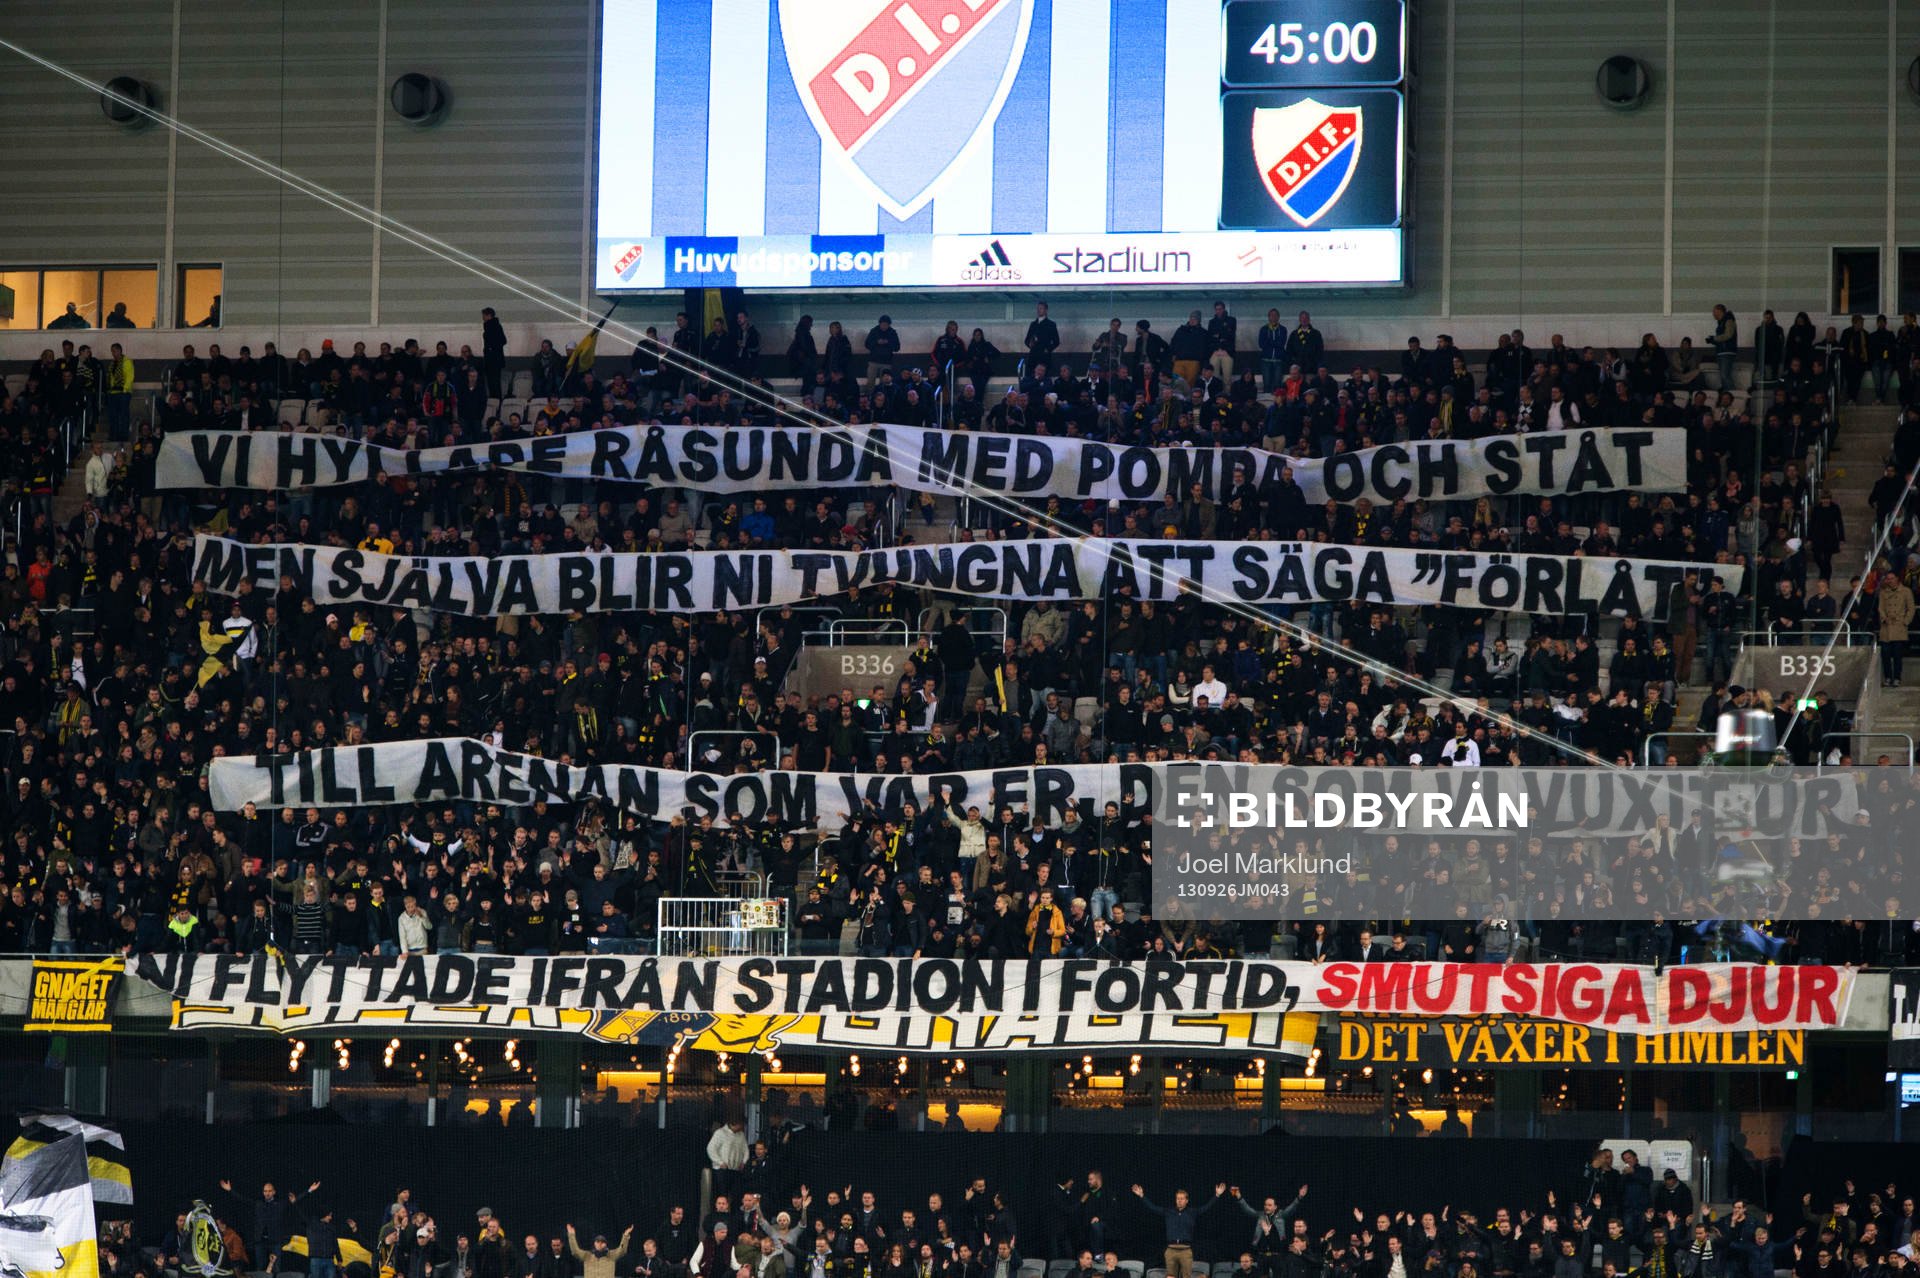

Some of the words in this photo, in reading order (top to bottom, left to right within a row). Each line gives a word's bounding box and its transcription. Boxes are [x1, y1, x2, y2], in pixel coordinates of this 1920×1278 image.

[1251, 22, 1378, 65] 45:00
[1278, 119, 1352, 188] D.I.F.
[673, 246, 914, 277] Huvudsponsorer
[960, 267, 1023, 281] adidas
[1052, 247, 1192, 274] stadium
[191, 434, 251, 487] VI
[590, 426, 894, 483] RÅSUNDA
[918, 430, 1054, 494] MED
[1323, 443, 1456, 499] OCH
[1484, 431, 1653, 495] STÅT
[195, 539, 316, 602] MEN
[328, 553, 539, 614] SJÄLVA
[558, 555, 695, 610] BLIR
[713, 553, 773, 608] NI
[791, 542, 1083, 598] TVUNGNA
[1100, 541, 1215, 602] ATT
[1233, 544, 1395, 602] SÄGA
[840, 654, 896, 677] B336
[1780, 655, 1836, 677] B335
[256, 746, 395, 805] TILL
[413, 740, 659, 816] ARENAN
[684, 771, 820, 832] SOM
[1266, 767, 1412, 830] SOM
[35, 971, 113, 1000] GNAGET
[208, 952, 516, 1006] FLYTTADE
[526, 956, 721, 1012] IFRÅN
[733, 957, 1004, 1015] STADION
[1023, 959, 1042, 1012] I
[1059, 959, 1301, 1013] FÖRTID,
[1316, 961, 1651, 1025] SMUTSIGA
[1668, 965, 1838, 1025] DJUR
[31, 998, 107, 1020] MANGLAR
[1338, 1021, 1429, 1062] DET
[1440, 1019, 1591, 1063] VÄXER
[1604, 1029, 1621, 1063] I
[1634, 1031, 1805, 1065] HIMLEN
